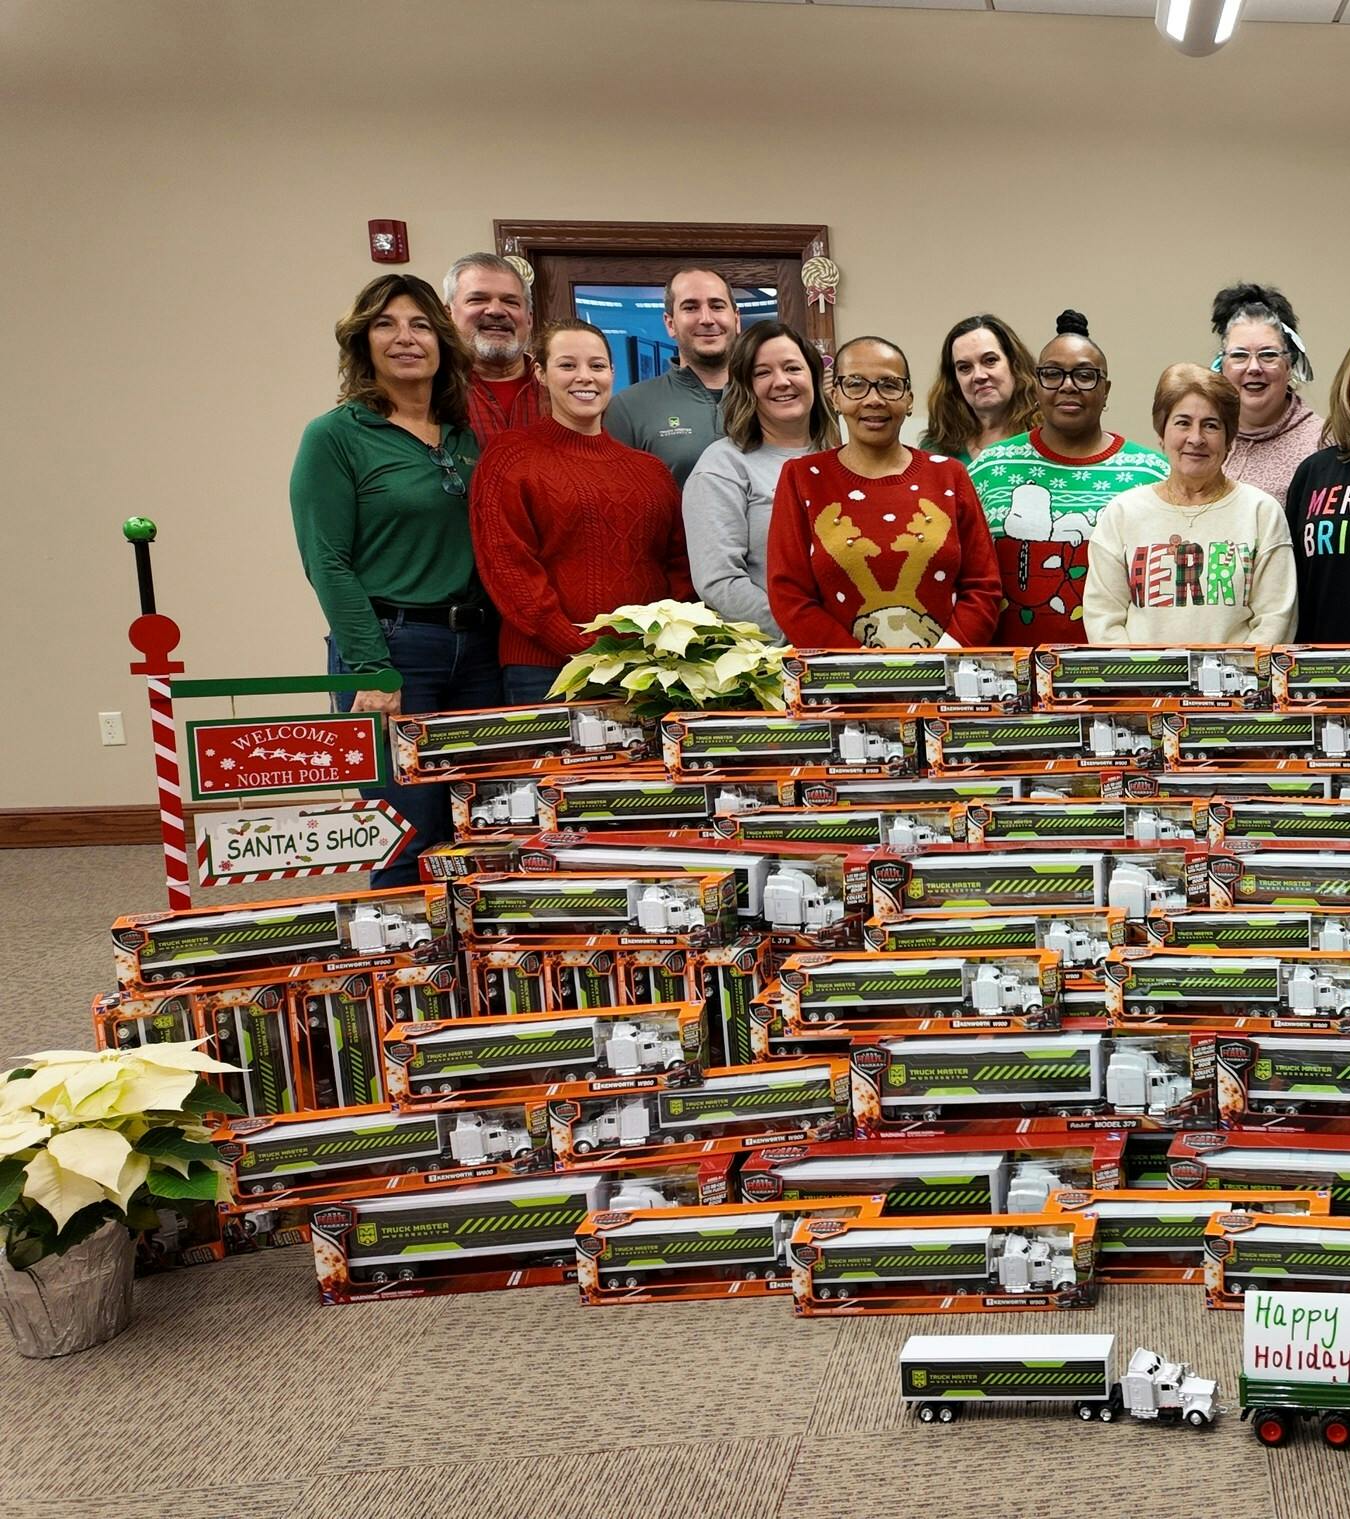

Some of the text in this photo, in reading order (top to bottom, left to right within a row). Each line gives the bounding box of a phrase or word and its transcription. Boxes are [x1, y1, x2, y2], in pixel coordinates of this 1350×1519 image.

[231, 725, 339, 751] WELCOME
[237, 767, 340, 787] NORTH POLE
[227, 825, 380, 860] SANTA'S SHOP
[927, 882, 951, 890] TRUCK
[1275, 1064, 1300, 1072] TRUCK
[1122, 1120, 1137, 1128] 379
[381, 1225, 411, 1234] TRUCK
[1256, 1295, 1339, 1349] Happy
